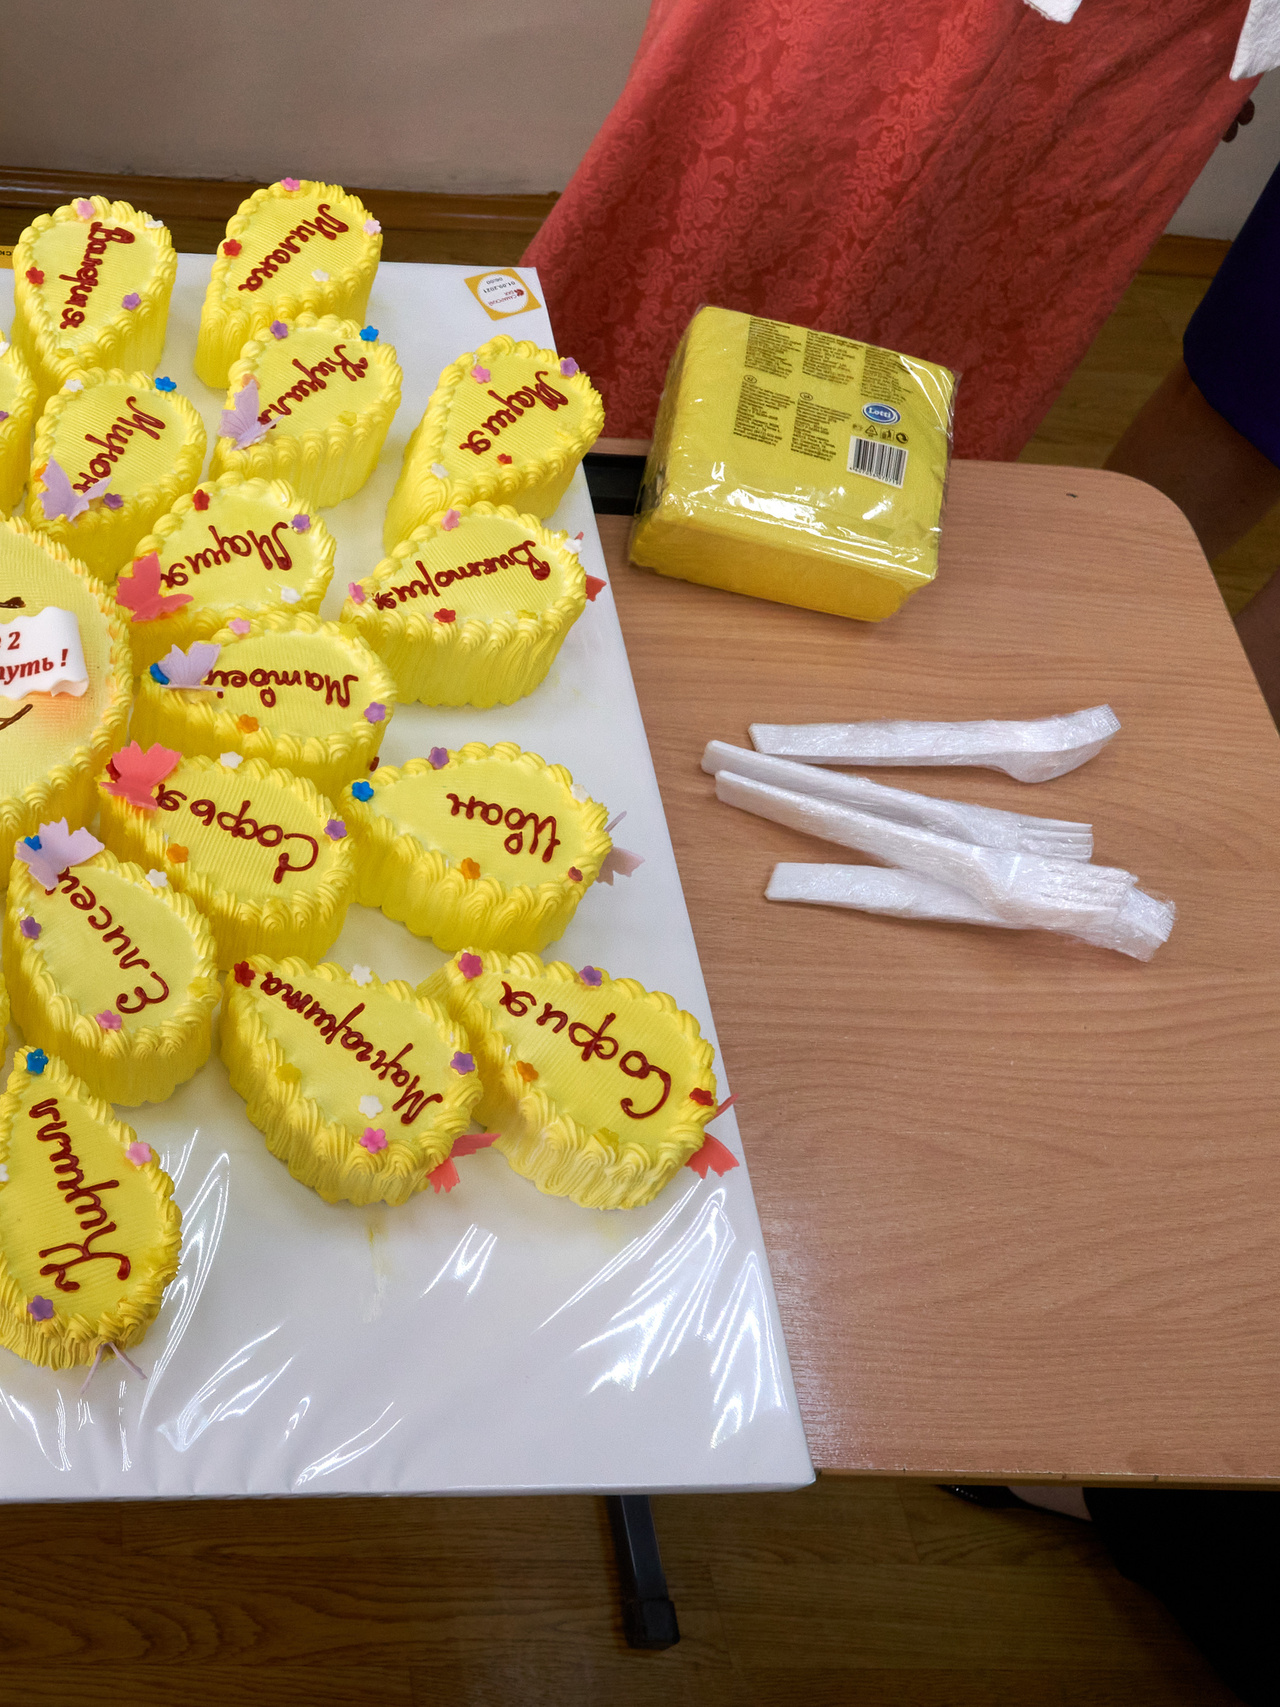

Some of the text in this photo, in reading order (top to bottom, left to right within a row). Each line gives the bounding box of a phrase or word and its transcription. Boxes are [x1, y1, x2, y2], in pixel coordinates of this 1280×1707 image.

[60, 222, 134, 328] Валерия
[239, 204, 348, 291] Милана
[74, 397, 164, 493] Мирон
[460, 372, 568, 454] Мария
[867, 407, 892, 419] Lotti
[160, 522, 291, 587] Мария
[375, 541, 550, 609] Виктория
[7, 631, 21, 651] 2
[155, 784, 318, 883] Софья
[447, 794, 560, 862] Иван
[261, 972, 442, 1124] Маргарита
[500, 982, 671, 1118] София
[30, 1100, 130, 1291] Кирилл
